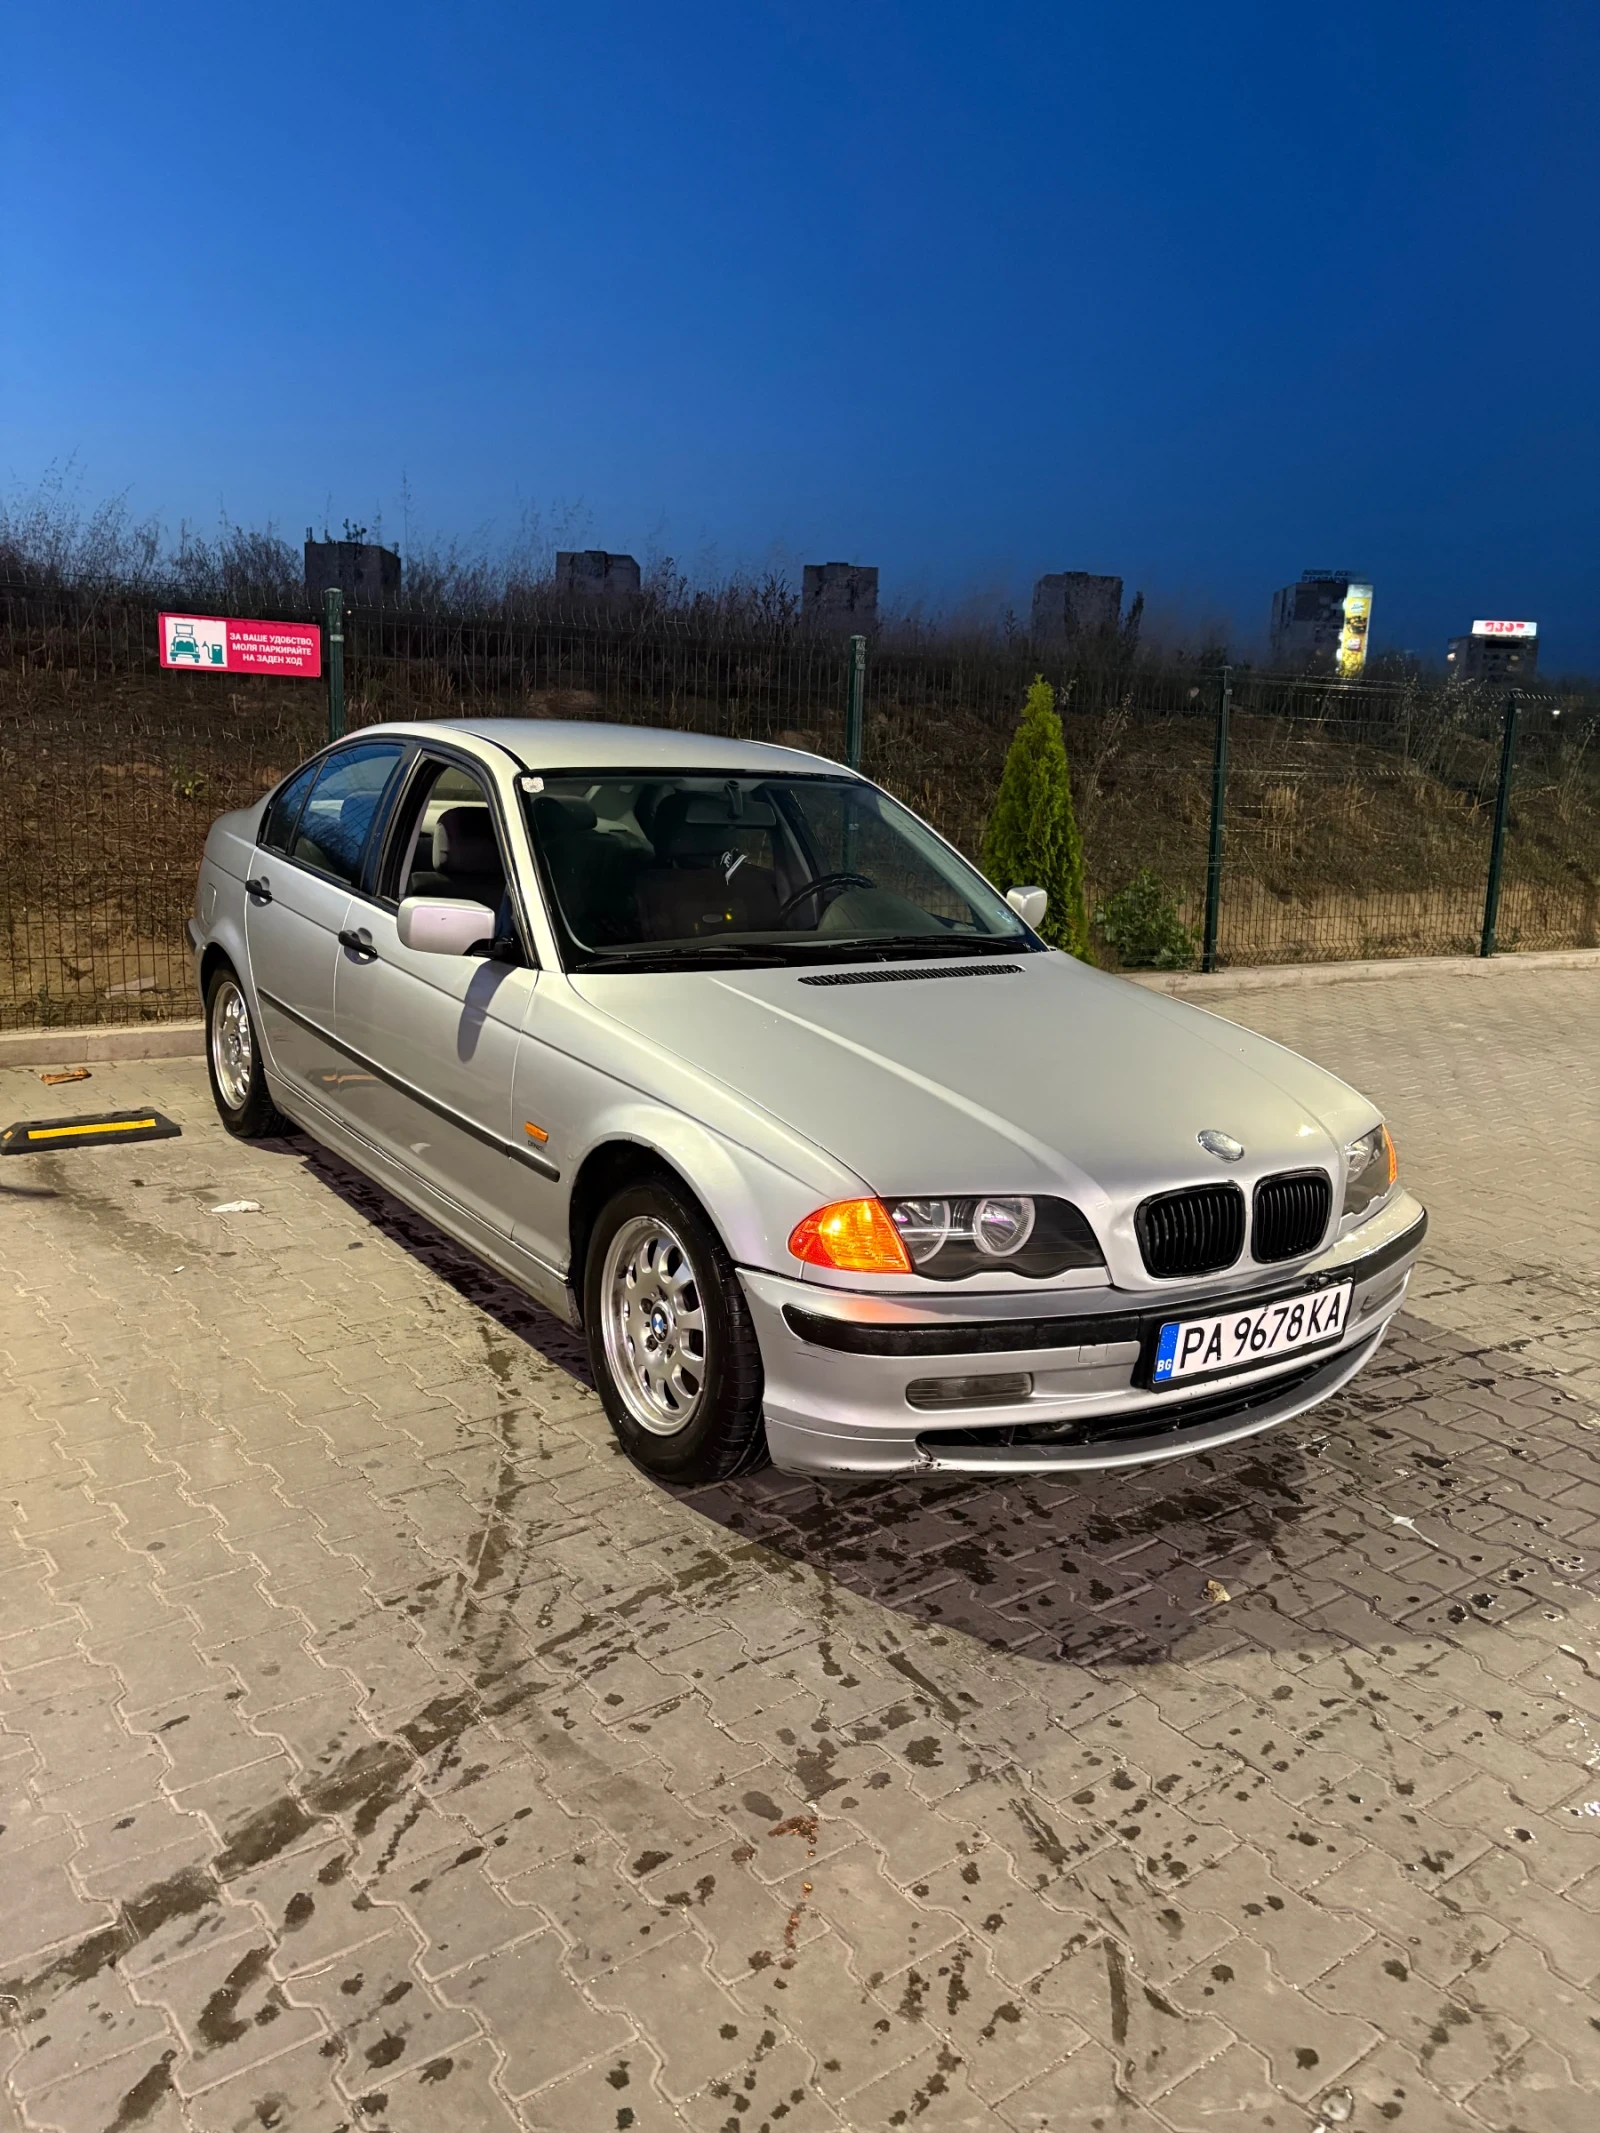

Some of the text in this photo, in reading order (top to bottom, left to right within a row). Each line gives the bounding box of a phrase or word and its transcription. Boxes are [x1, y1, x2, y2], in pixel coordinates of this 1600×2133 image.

[243, 634, 268, 642] ВАШЕ
[269, 635, 313, 646] УДОБСТВО,
[232, 643, 311, 655] МОЛЯ ПАРКИРАЙТЕ
[257, 655, 284, 664] ЗАДЕН
[286, 657, 303, 666] ХОД
[1179, 1322, 1222, 1369] PA
[1156, 1358, 1173, 1373] BG
